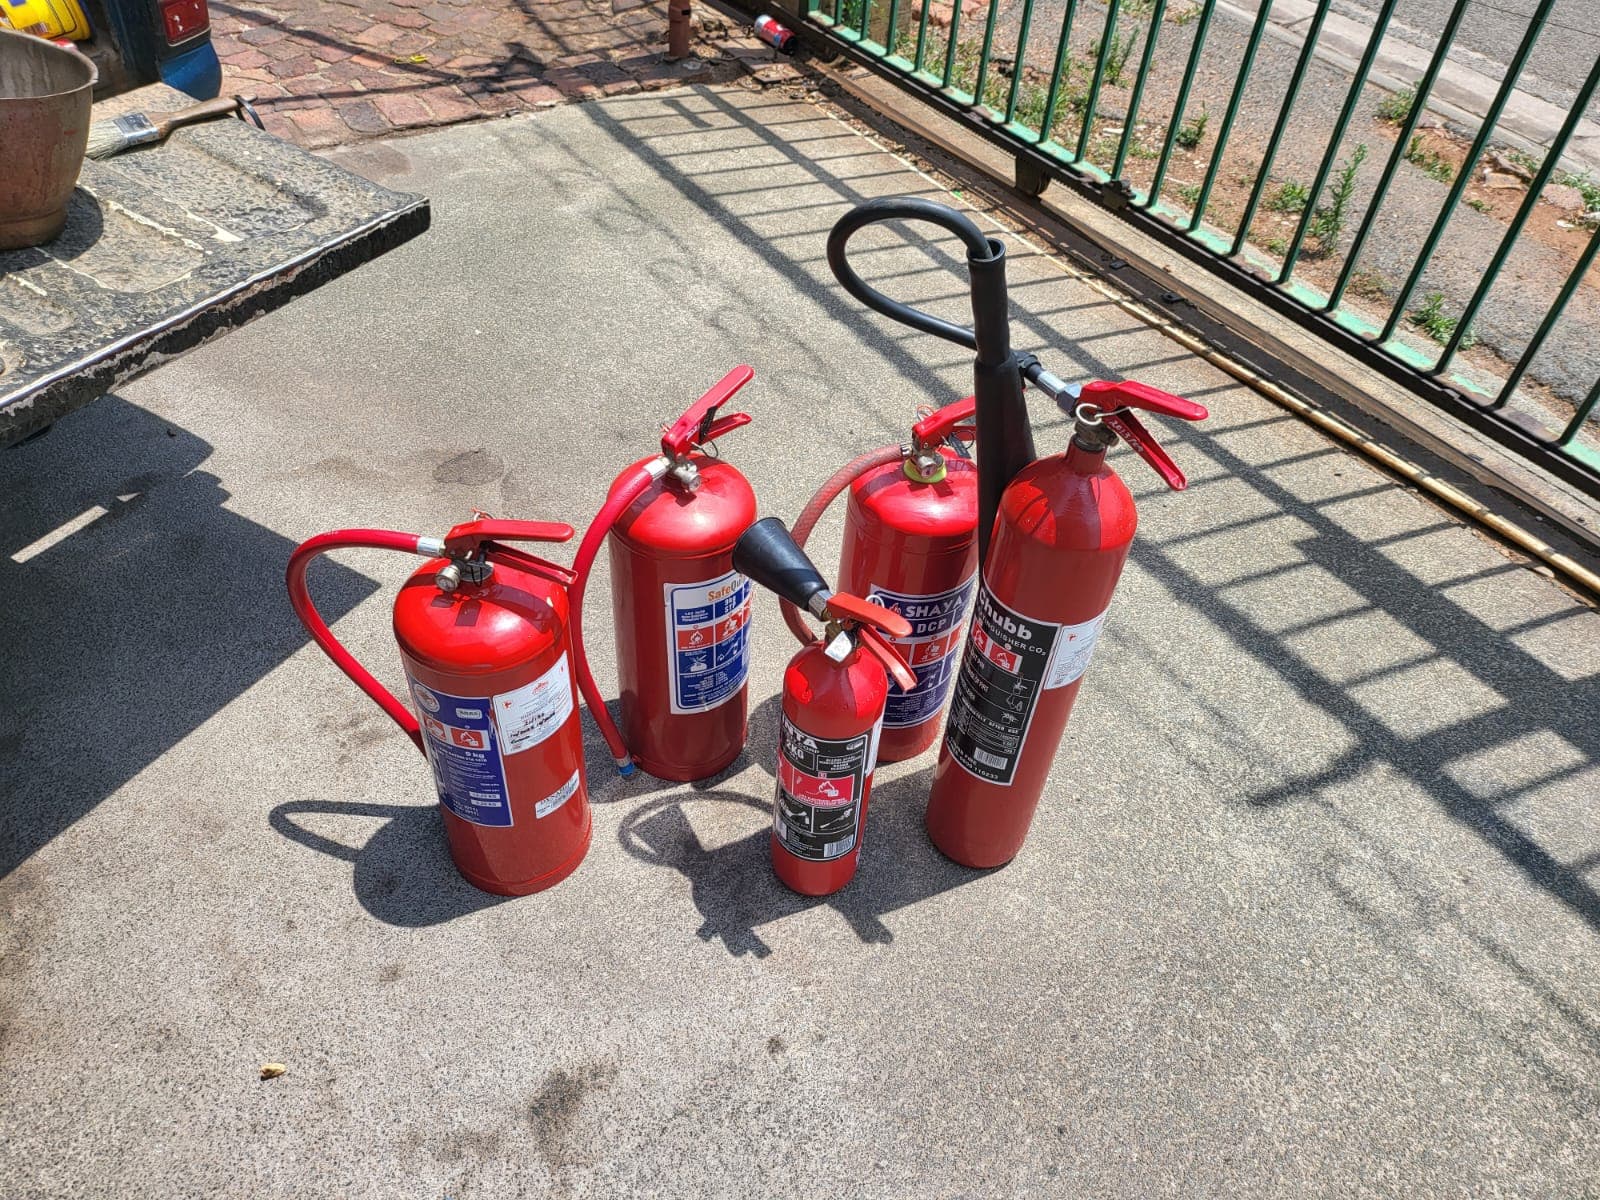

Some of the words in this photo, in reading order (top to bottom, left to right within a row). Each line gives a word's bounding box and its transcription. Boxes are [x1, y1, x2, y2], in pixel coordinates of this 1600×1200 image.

[708, 578, 742, 602] SafeQu
[905, 595, 963, 618] SHAYA
[979, 588, 1033, 640] Chubb
[917, 618, 947, 634] DCP
[978, 604, 1027, 650] TINGUISHER
